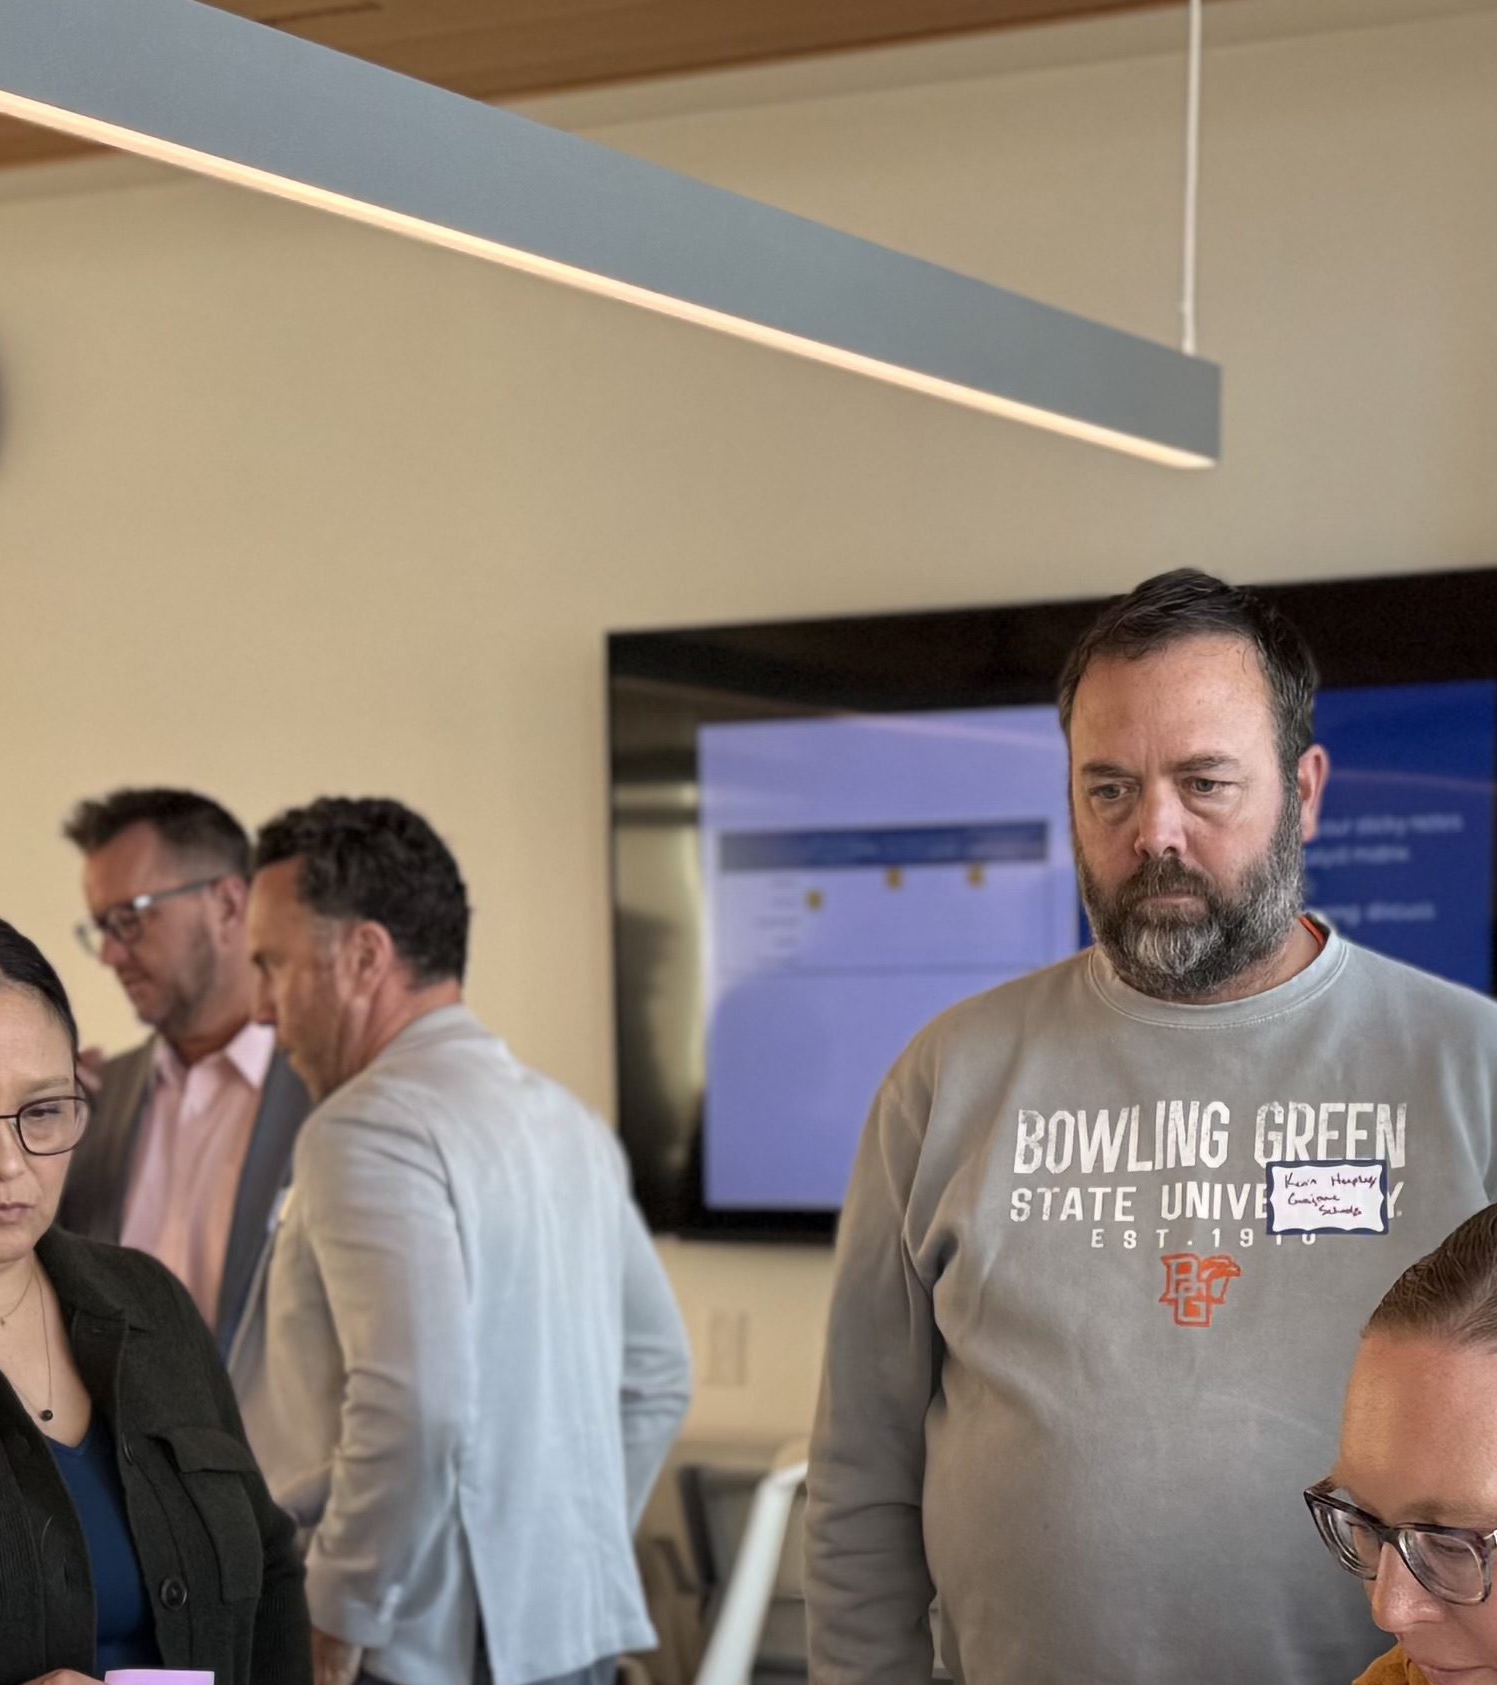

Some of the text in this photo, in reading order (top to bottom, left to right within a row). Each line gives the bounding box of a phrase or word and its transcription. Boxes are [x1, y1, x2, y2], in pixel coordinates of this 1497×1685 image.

[1013, 1100, 1407, 1174] BOWLING GREEN
[1284, 1172, 1317, 1188] Kevin
[1010, 1181, 1404, 1222] STATE UNIVEY
